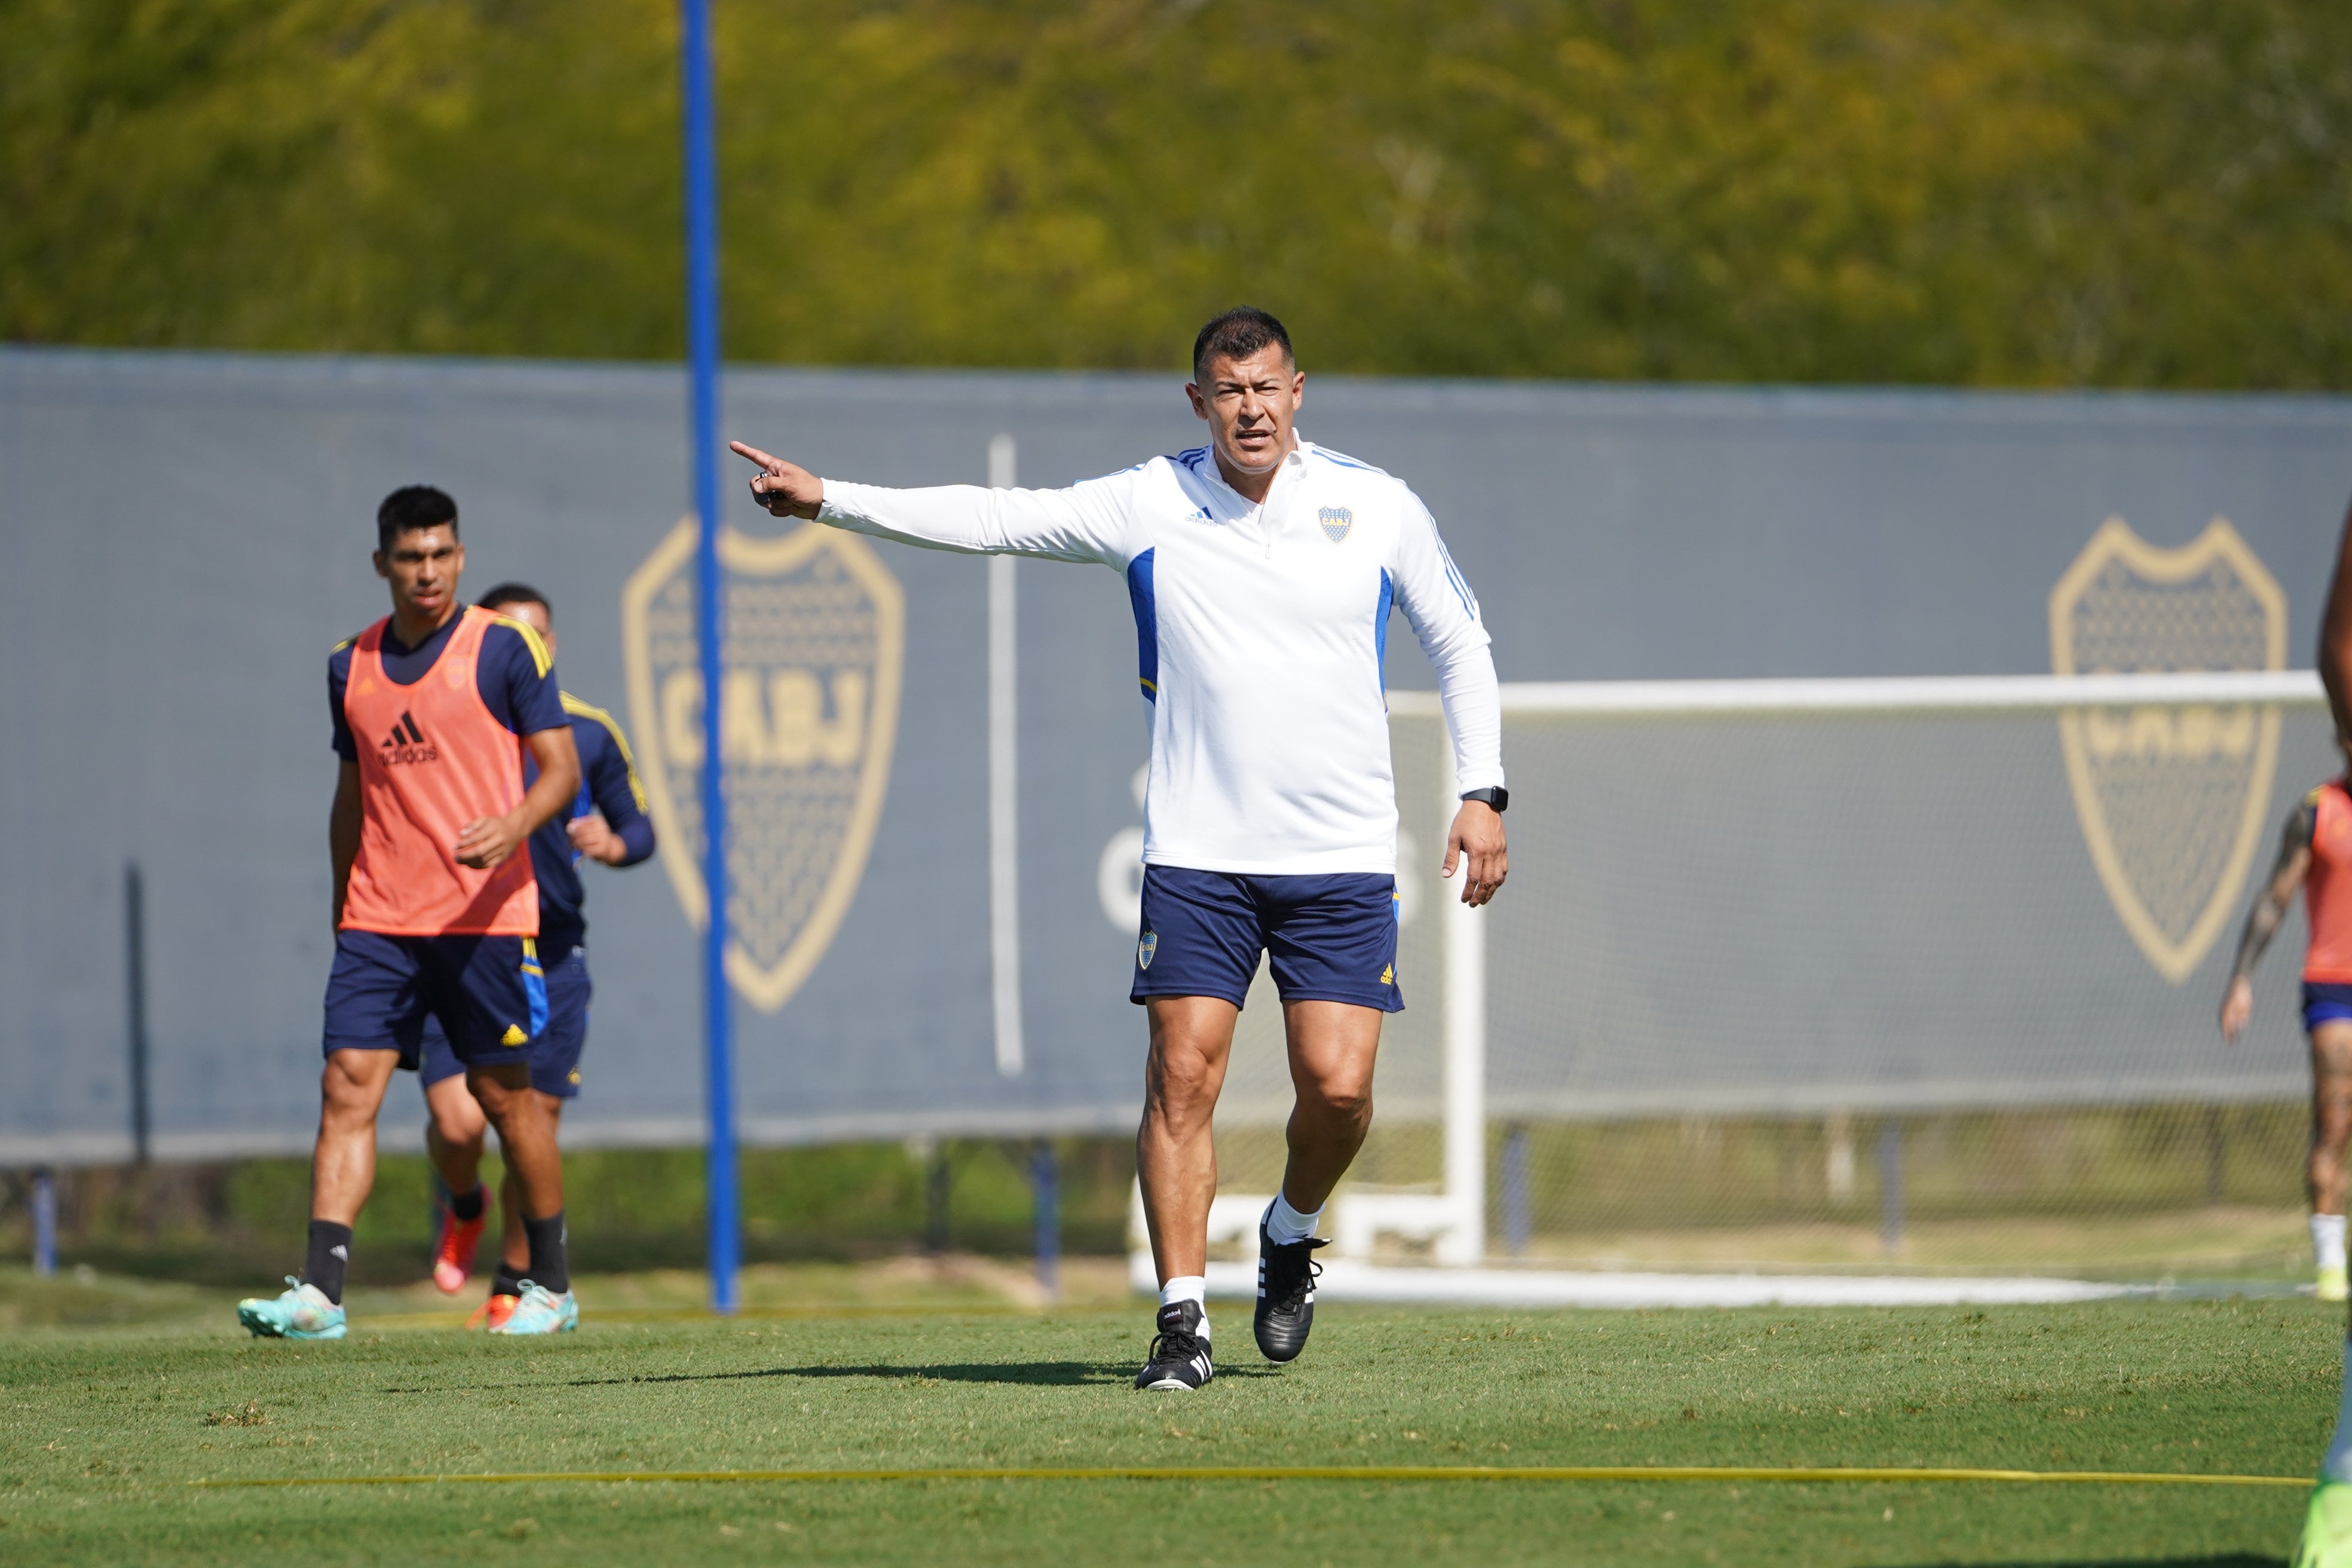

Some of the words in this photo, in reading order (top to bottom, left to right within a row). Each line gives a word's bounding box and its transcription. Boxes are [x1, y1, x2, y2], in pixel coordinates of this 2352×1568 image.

[1185, 516, 1218, 527] adidas
[1321, 517, 1350, 526] CABJ
[377, 746, 438, 766] adidas
